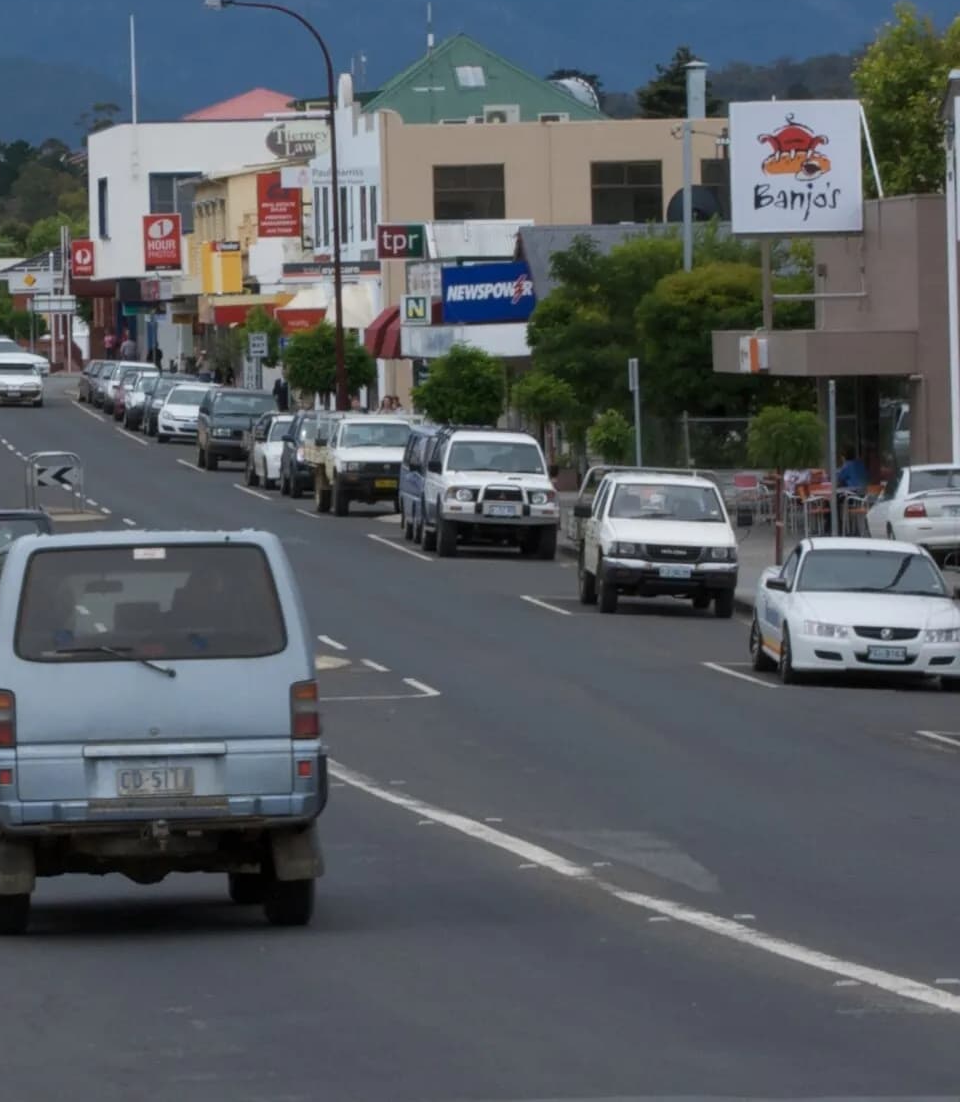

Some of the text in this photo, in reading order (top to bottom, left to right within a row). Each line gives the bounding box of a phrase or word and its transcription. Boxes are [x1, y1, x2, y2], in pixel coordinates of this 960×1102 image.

[272, 127, 328, 145] Tierney
[285, 142, 316, 157] Law
[754, 182, 841, 221] Banjo's
[147, 238, 176, 250] HOUR
[382, 231, 419, 254] tpr
[147, 251, 177, 259] PHOTOS
[446, 278, 534, 303] NEWSPOWER
[407, 299, 425, 319] N
